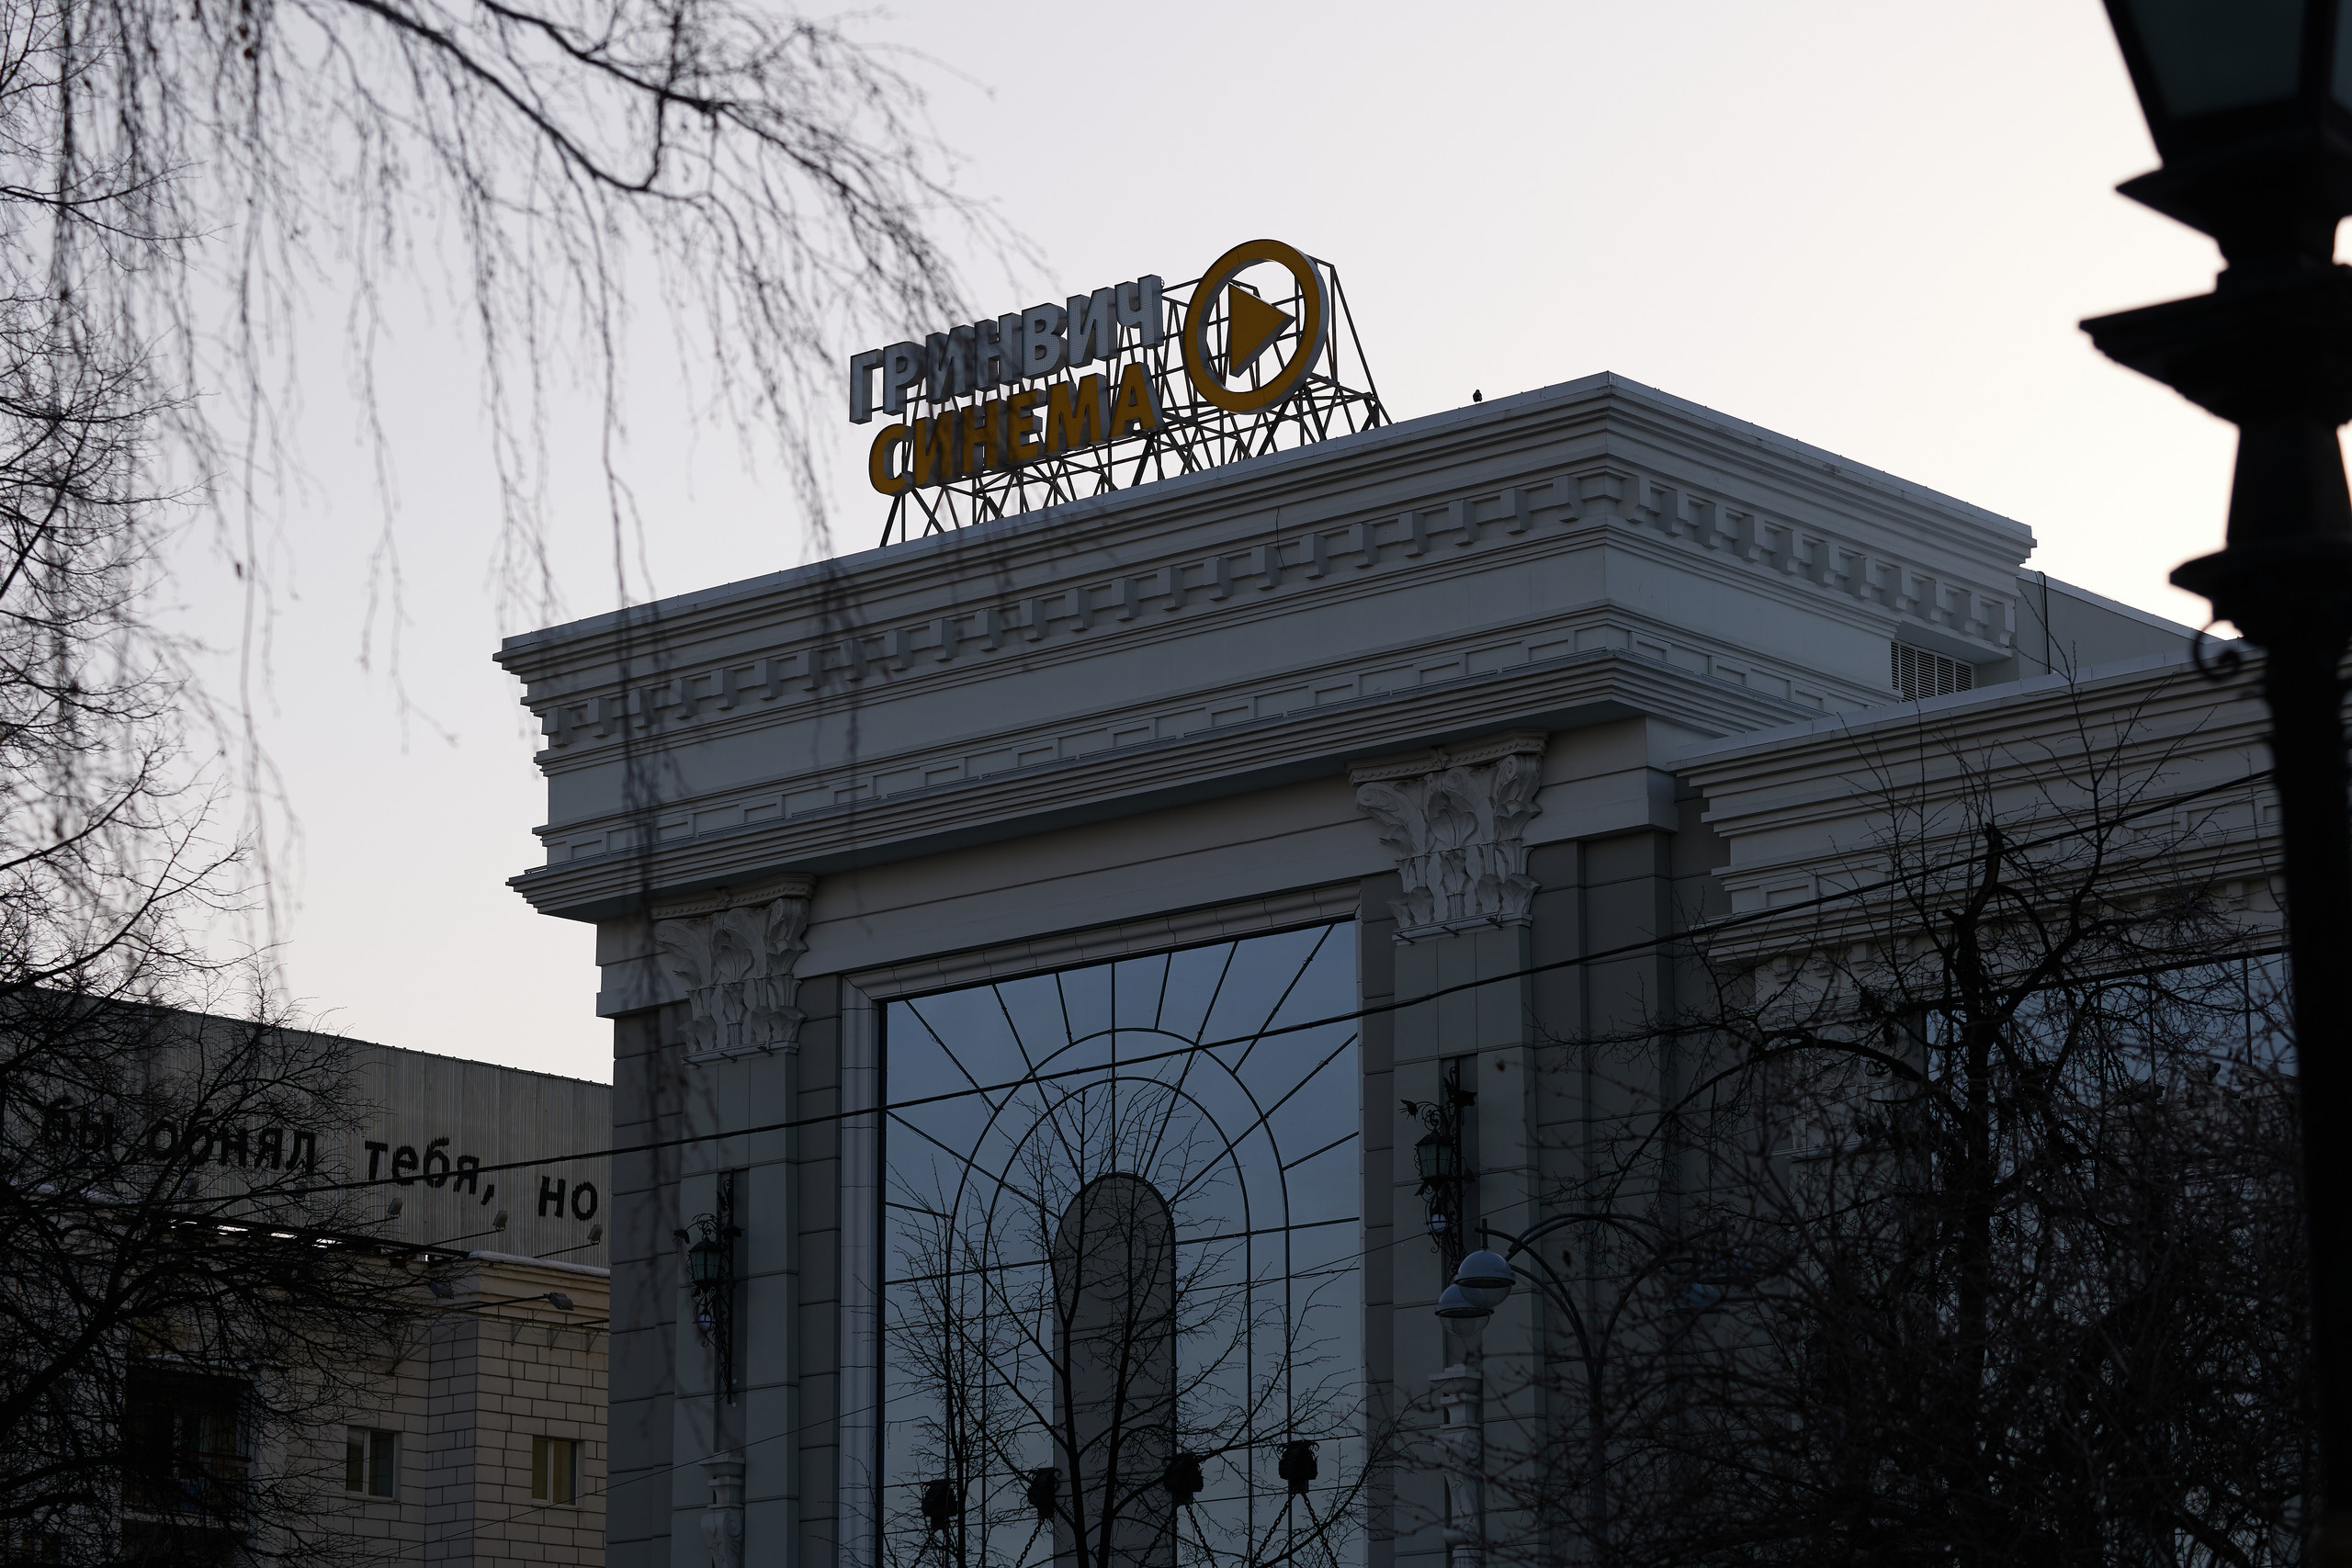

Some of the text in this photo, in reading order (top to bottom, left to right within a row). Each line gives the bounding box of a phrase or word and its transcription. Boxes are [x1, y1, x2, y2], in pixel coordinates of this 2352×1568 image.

[850, 275, 1163, 423] ГРИНВИЧ
[870, 362, 1164, 497] СИНЕМА
[365, 1137, 495, 1206] тебя,
[538, 1176, 598, 1222] но
